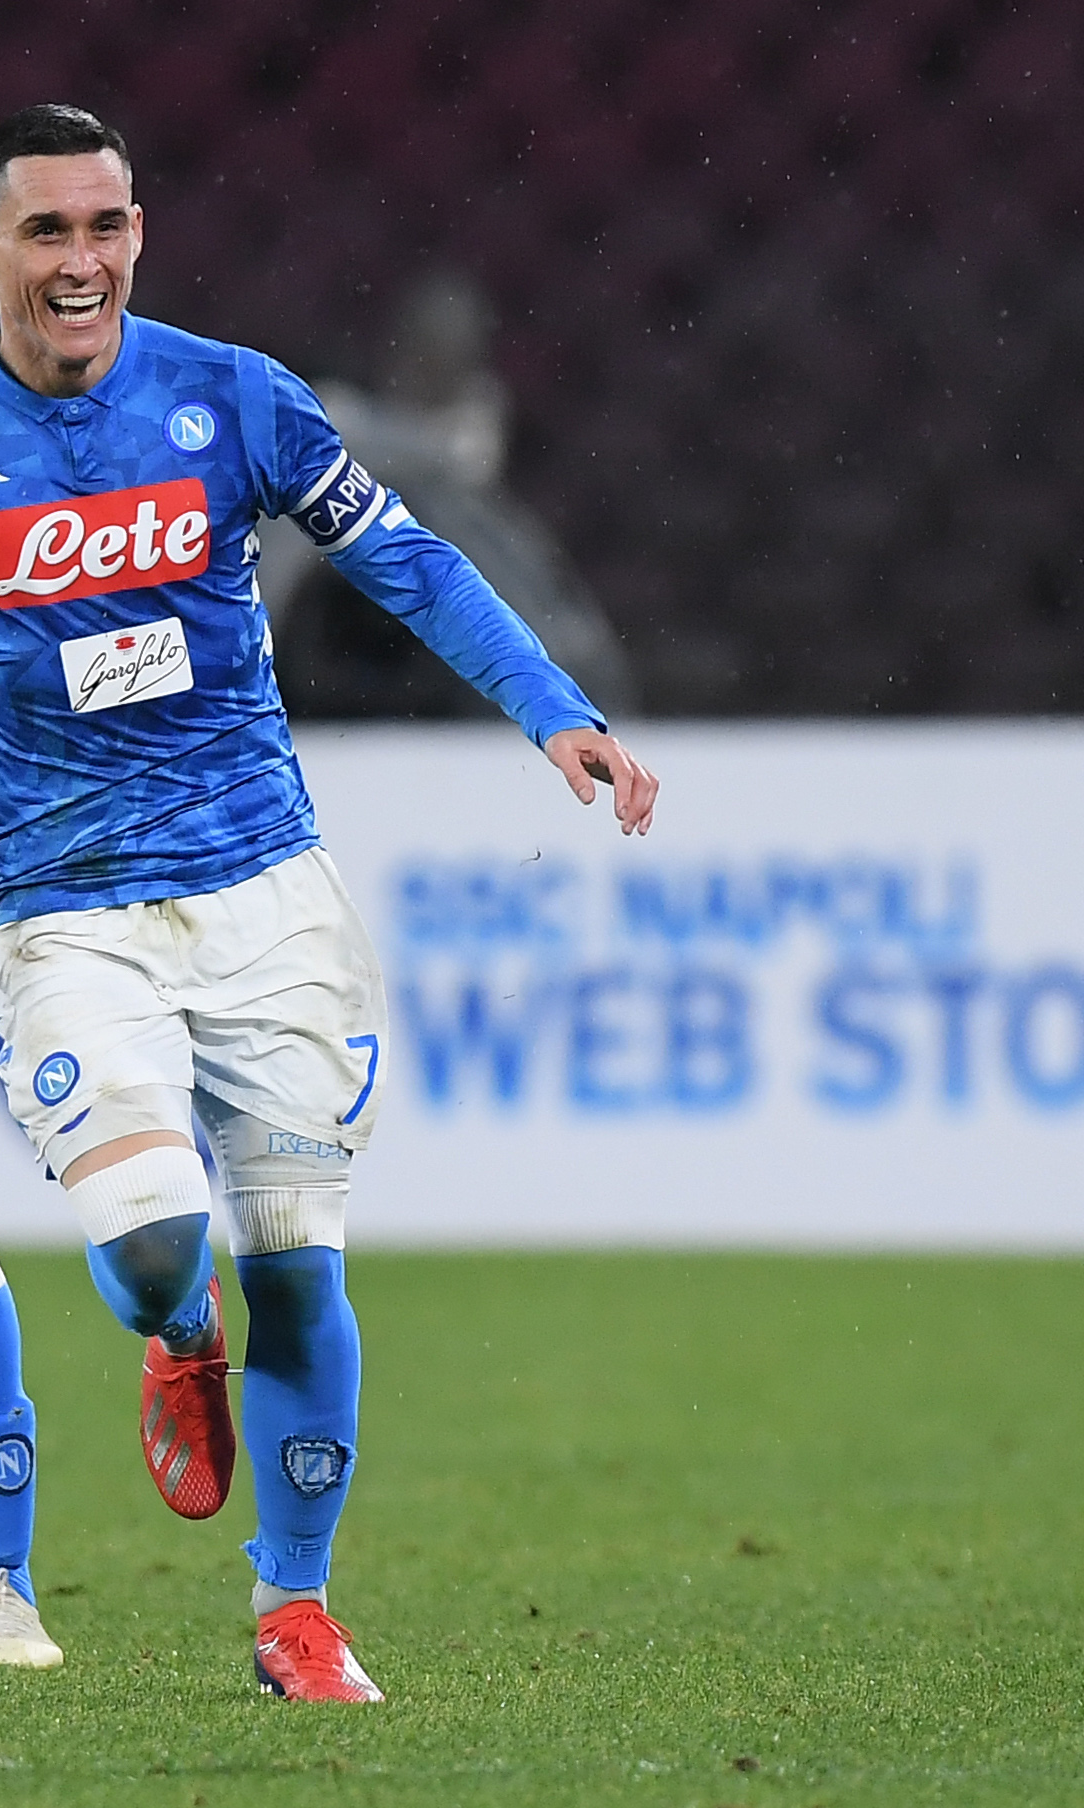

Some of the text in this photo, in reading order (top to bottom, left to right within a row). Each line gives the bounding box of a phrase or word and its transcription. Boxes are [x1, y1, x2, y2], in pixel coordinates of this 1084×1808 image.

[179, 414, 204, 442] N
[74, 632, 187, 712] Garofalo
[398, 962, 1084, 1113] WEB STO
[43, 1062, 67, 1094] N
[343, 1033, 379, 1125] 7
